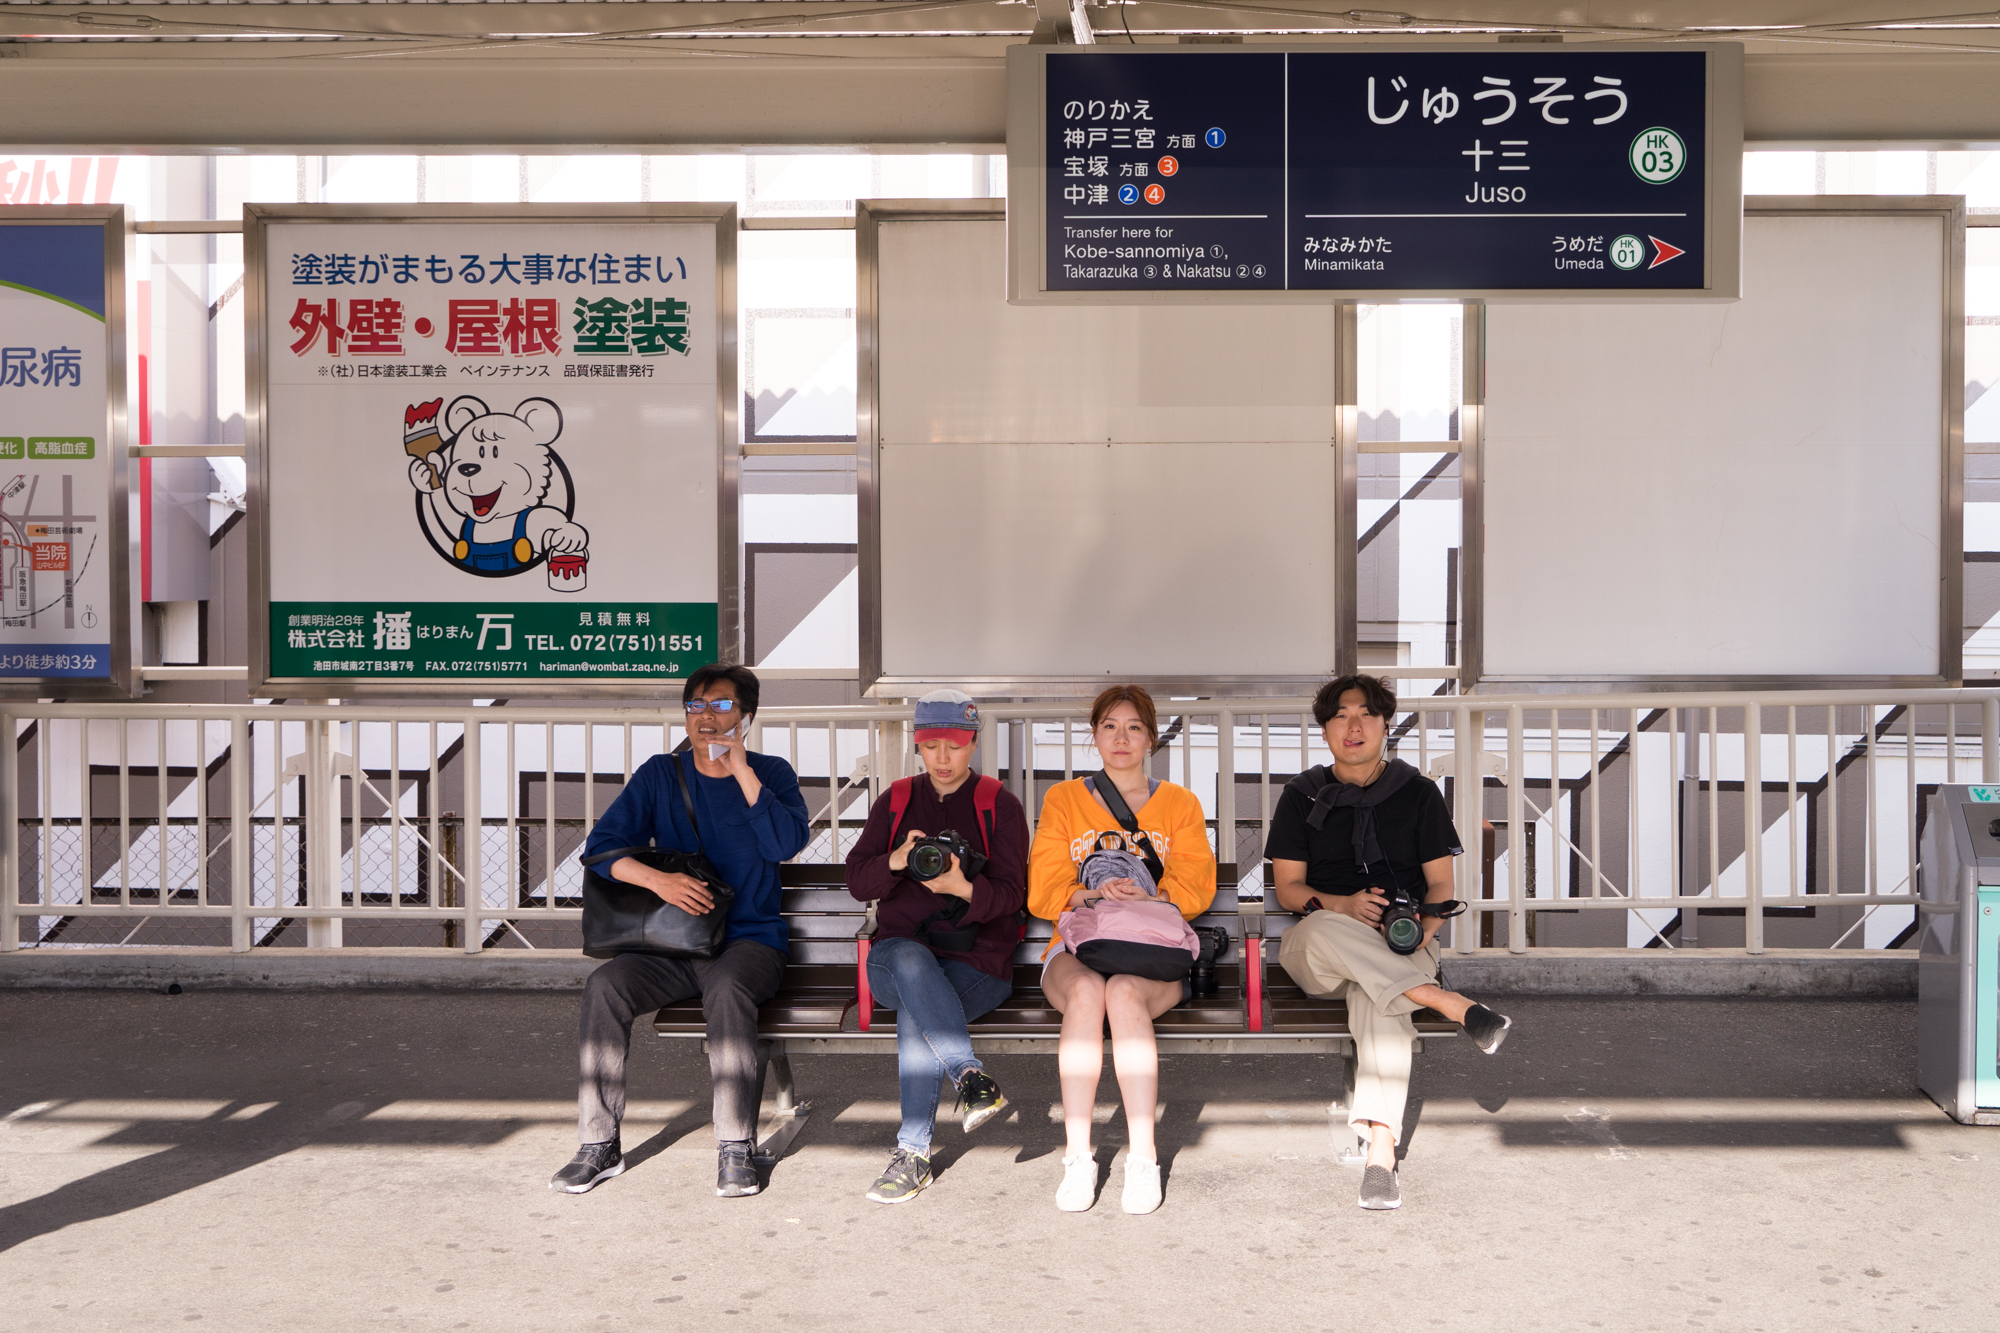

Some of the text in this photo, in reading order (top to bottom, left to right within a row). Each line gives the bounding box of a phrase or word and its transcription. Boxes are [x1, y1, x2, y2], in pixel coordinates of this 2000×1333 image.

[1368, 76, 1627, 125] じゅうそう
[1064, 100, 1153, 120] のりかえ
[1064, 128, 1155, 149] 神戸三宮
[1167, 135, 1195, 148] 方面
[1646, 134, 1670, 149] HK
[1462, 139, 1530, 172] 十三
[1640, 151, 1675, 173] 03
[1064, 156, 1108, 177] 宝塚
[1120, 163, 1148, 176] 方面
[1064, 184, 1108, 205] 中津
[1466, 182, 1526, 203] Juso
[1064, 227, 1173, 238] Transfer here for
[1304, 237, 1392, 253] みなみかた
[1553, 236, 1603, 252] うめだ
[1619, 239, 1635, 248] HK
[1065, 244, 1204, 261] Kobe-sannomiya
[1617, 249, 1636, 264] 01
[292, 253, 686, 285] 塗装がまもる大事な住まい
[1063, 264, 1138, 278] Takarazuka
[1163, 264, 1172, 278] &
[1177, 264, 1230, 277] Nakatsu
[1305, 259, 1384, 270] Minamikata
[1555, 258, 1604, 269] Umeda
[573, 297, 691, 357] 塗装
[0, 345, 82, 387] 尿病
[460, 365, 550, 377] ペインテナンス
[564, 364, 654, 377] 品質保証書発行
[0, 442, 18, 455] 化
[35, 442, 87, 454] 高脂血症
[36, 545, 67, 560] 当院
[19, 571, 27, 607] 阪急梅田駅
[288, 615, 364, 626] 創業明治28年
[579, 612, 650, 626] 見積無料
[288, 611, 514, 650] 株式会社 播 はりまん 万
[525, 634, 701, 652] TEL. 072(751)1551
[0, 654, 97, 669] より徒歩約3分
[313, 661, 679, 673] 池田市城南2丁目3番7号 FAX. 072(751)5771 hariman@wombat.zaq.ne.jp
